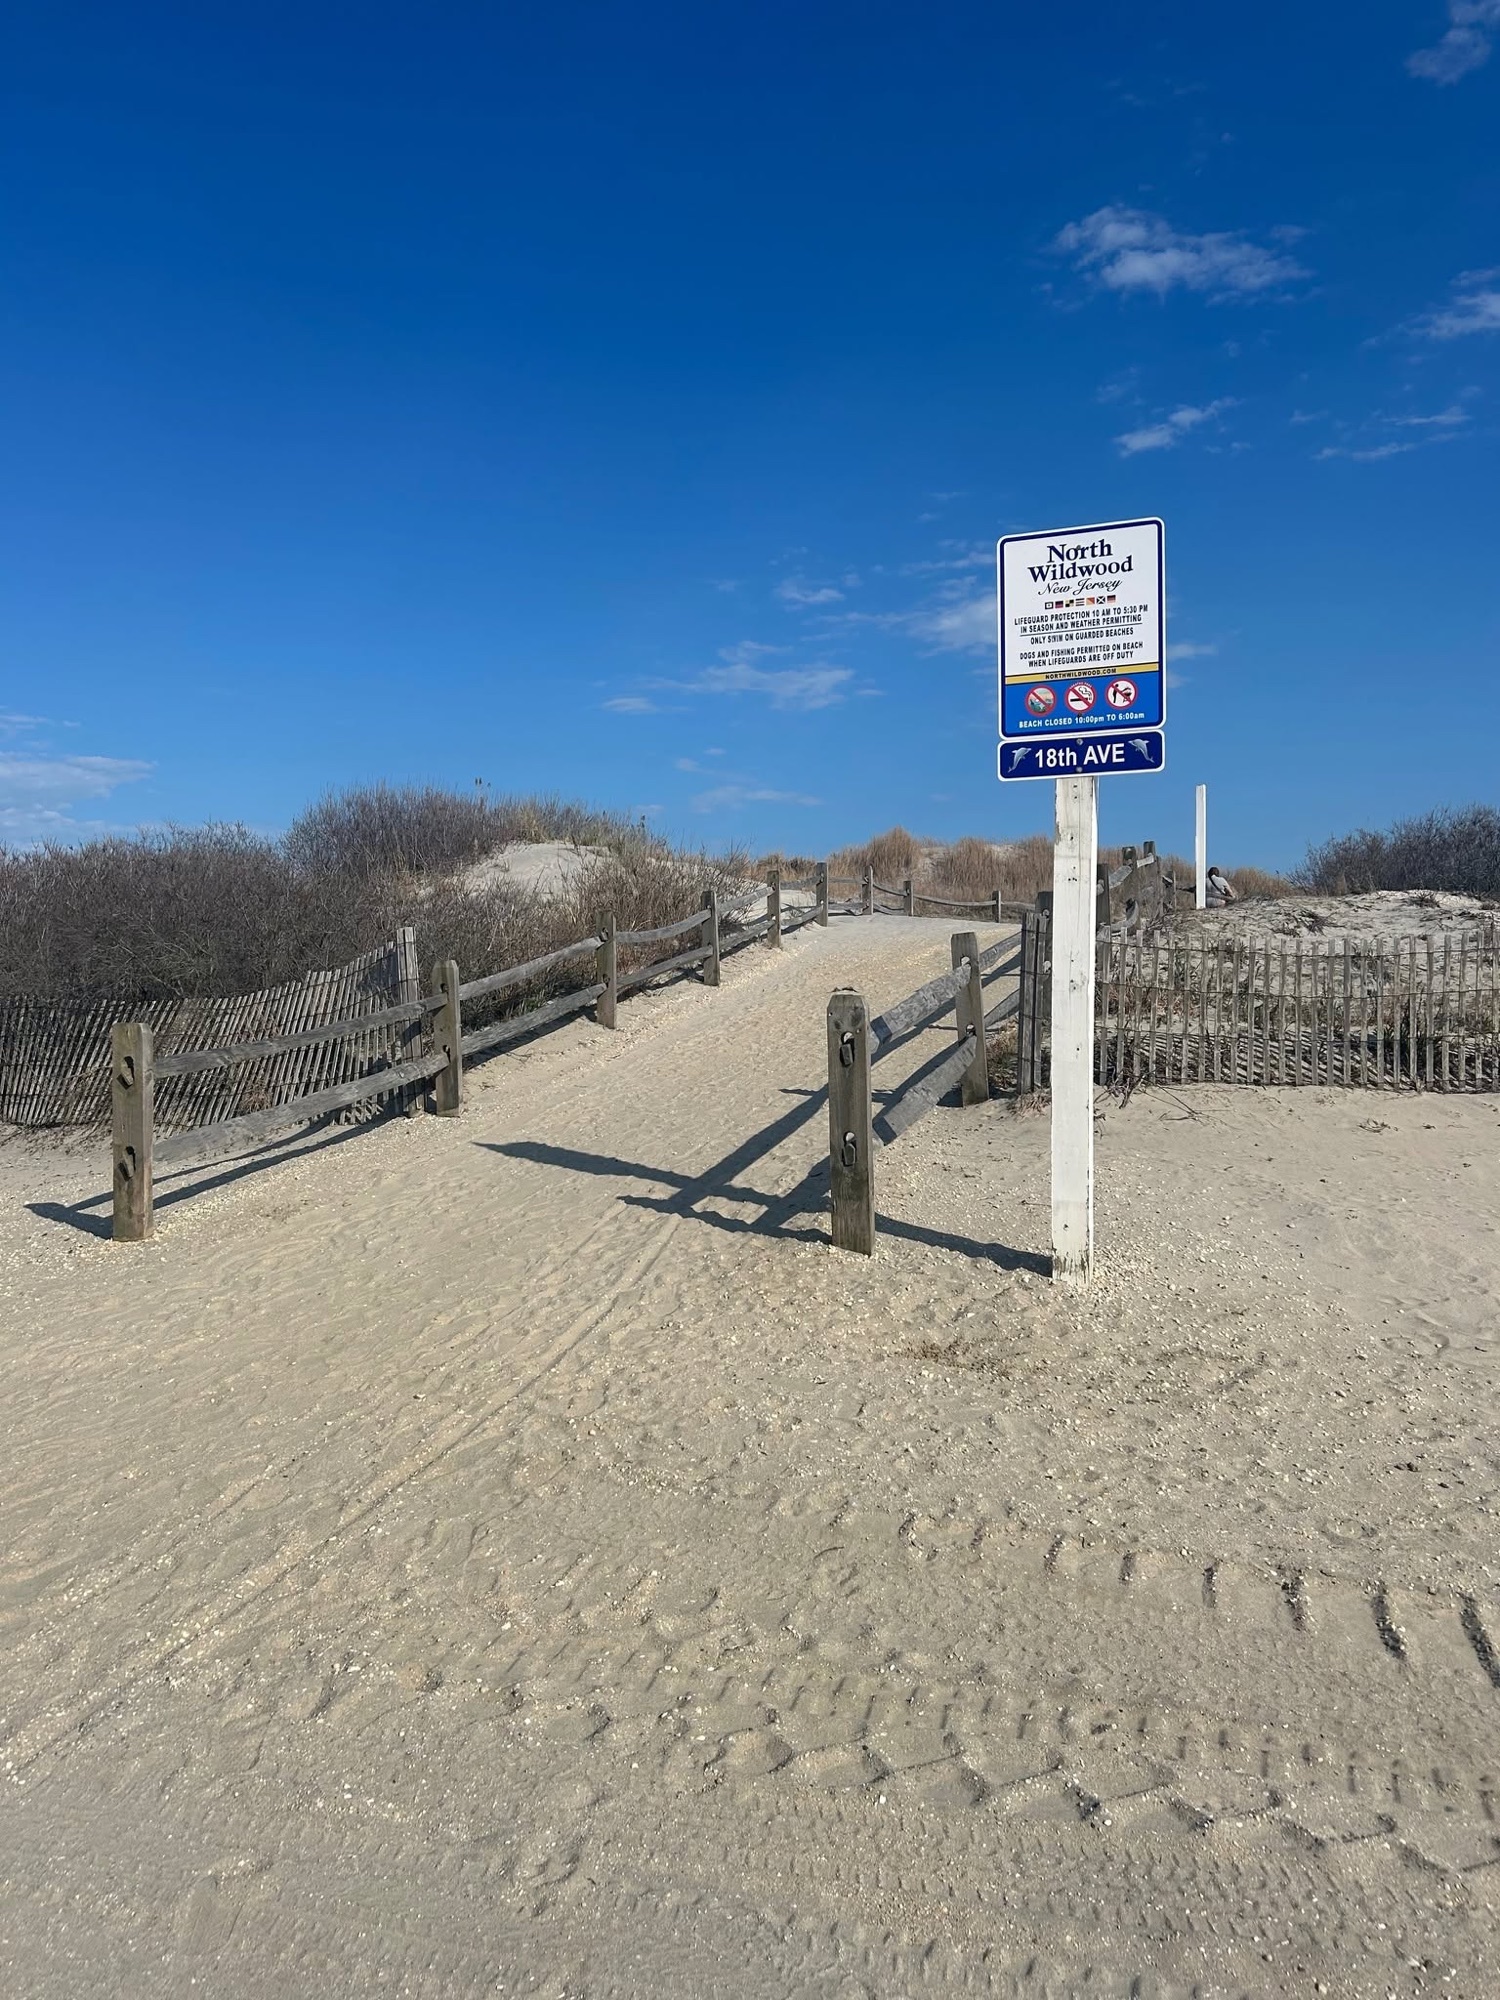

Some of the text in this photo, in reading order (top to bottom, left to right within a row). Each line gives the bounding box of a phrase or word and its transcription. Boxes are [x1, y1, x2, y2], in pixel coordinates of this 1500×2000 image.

[1047, 539, 1112, 563] North
[1028, 555, 1133, 582] Wildwood
[1038, 578, 1123, 595] New Jersey
[1014, 616, 1048, 625] LIFEGUARD
[1051, 611, 1090, 621] PROTECTION
[1124, 606, 1137, 614] 5:30
[1029, 623, 1053, 632] SEASON
[1071, 619, 1100, 628] WEATHER
[1103, 615, 1142, 625] PERMITTING
[1076, 631, 1103, 640] GUARDED
[1106, 628, 1133, 637] BEACHES
[1052, 648, 1074, 656] FISHING
[1077, 645, 1110, 655] PERMITTED
[1123, 642, 1143, 650] BEACH
[1048, 656, 1086, 665] LIFEGUARDS
[1117, 651, 1133, 659] DUTY
[1046, 669, 1116, 679] NORTHWILDWOOD.COM
[1036, 744, 1124, 768] 18th AVE
